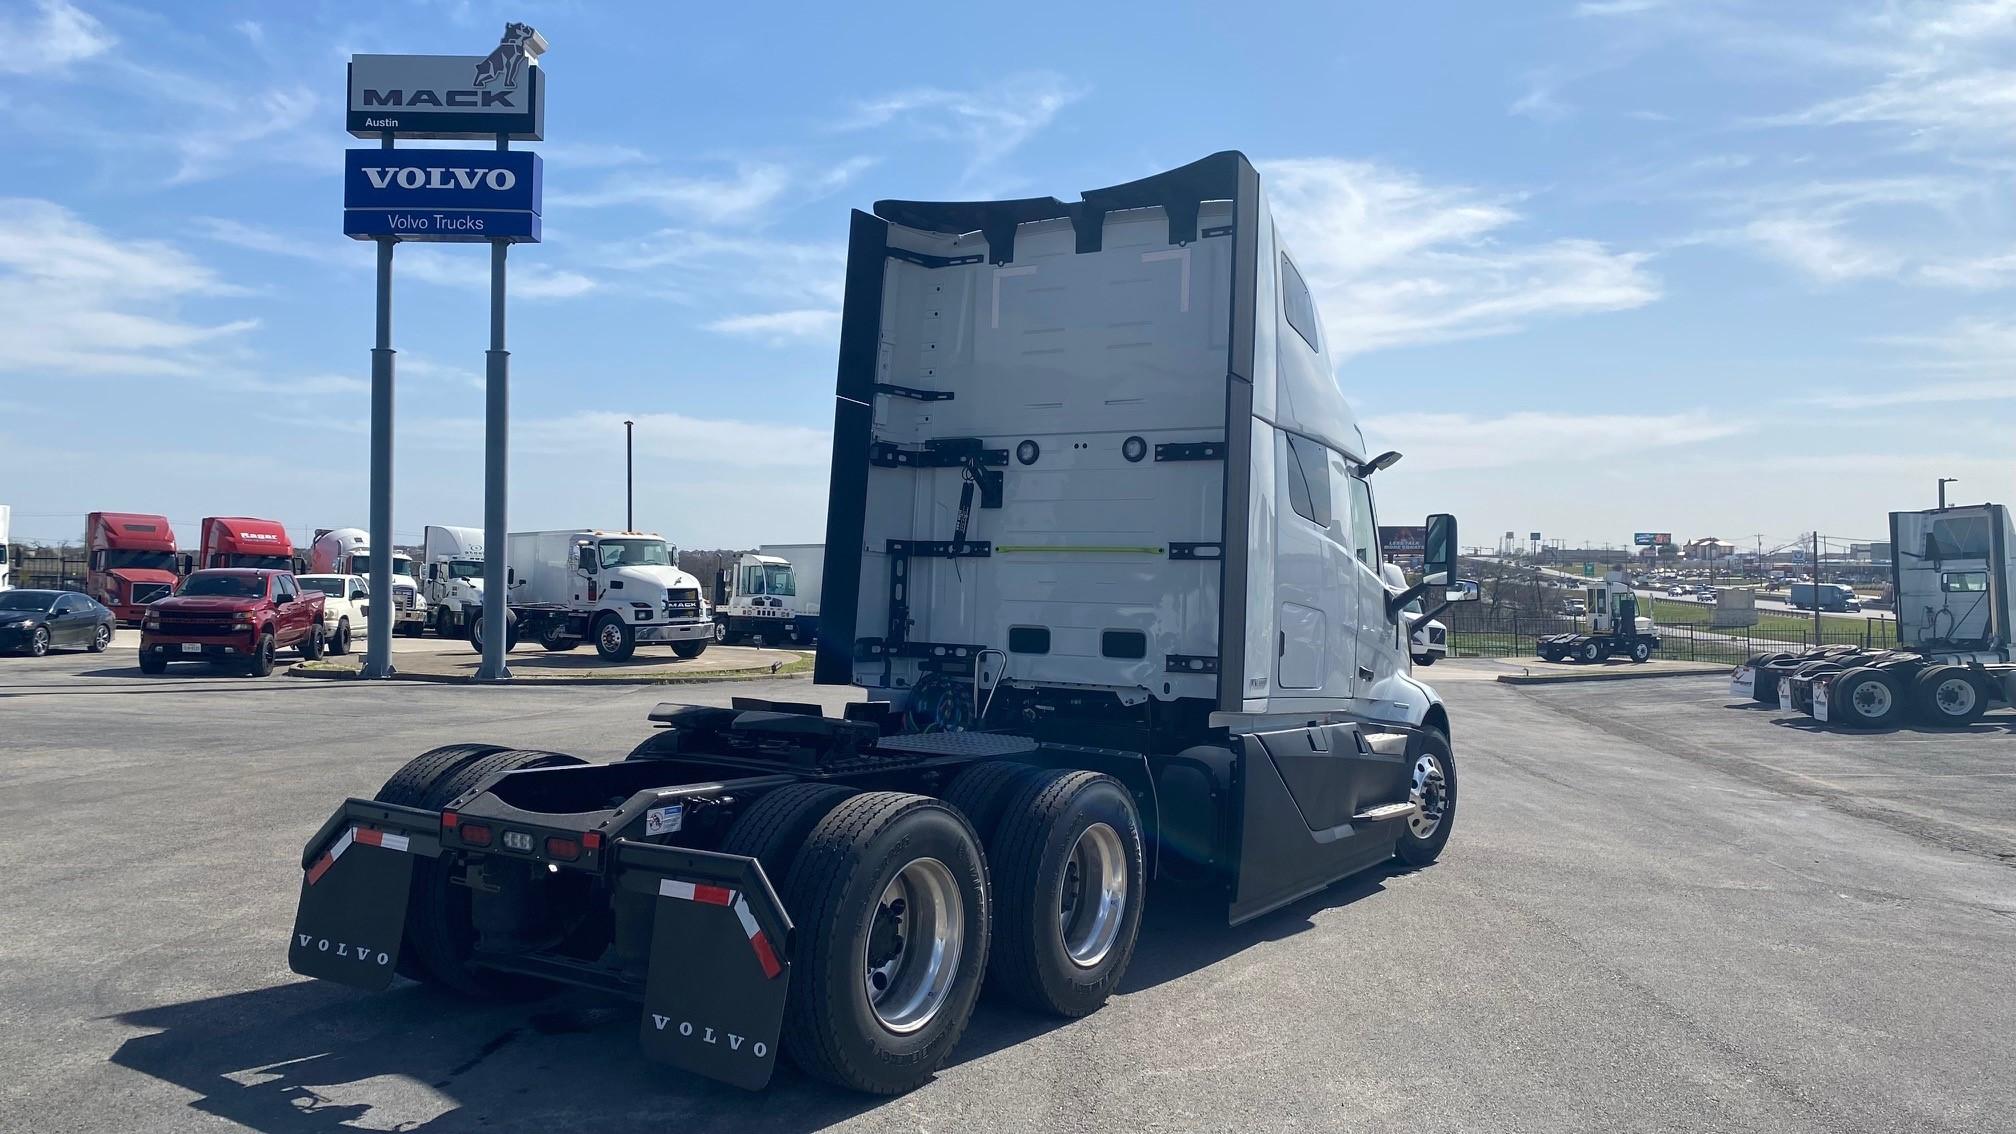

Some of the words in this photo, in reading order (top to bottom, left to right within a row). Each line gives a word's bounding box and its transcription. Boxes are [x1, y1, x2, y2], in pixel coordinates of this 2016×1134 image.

[363, 89, 516, 107] MACK
[365, 118, 399, 127] Austin
[361, 167, 516, 190] VOLVO
[387, 214, 428, 229] Volvo
[434, 215, 484, 230] Trucks
[299, 934, 389, 965] VOLVO
[652, 1014, 767, 1057] VOLVO
